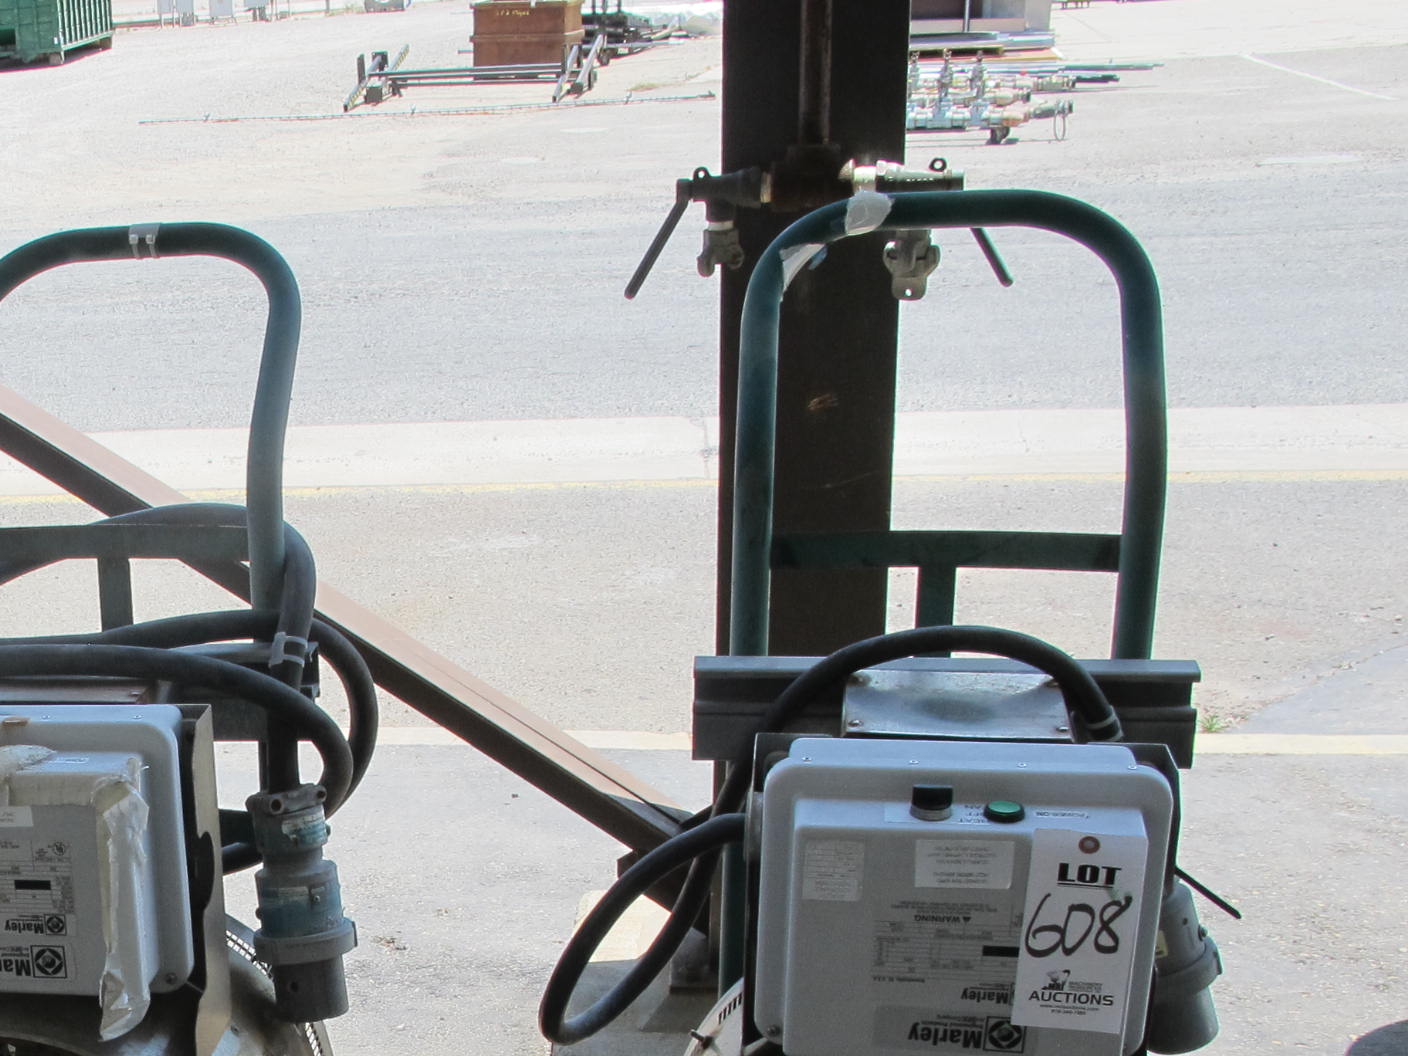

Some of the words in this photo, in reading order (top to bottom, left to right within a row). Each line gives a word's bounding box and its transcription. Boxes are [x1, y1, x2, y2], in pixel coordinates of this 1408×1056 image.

[1057, 863, 1122, 886] LOT
[913, 914, 961, 923] WARNING
[1024, 892, 1133, 958] 608
[4, 920, 44, 934] Marley
[960, 988, 1009, 1004] Marley
[1028, 990, 1114, 1006] AUCTIONS
[907, 1022, 983, 1049] Marley
